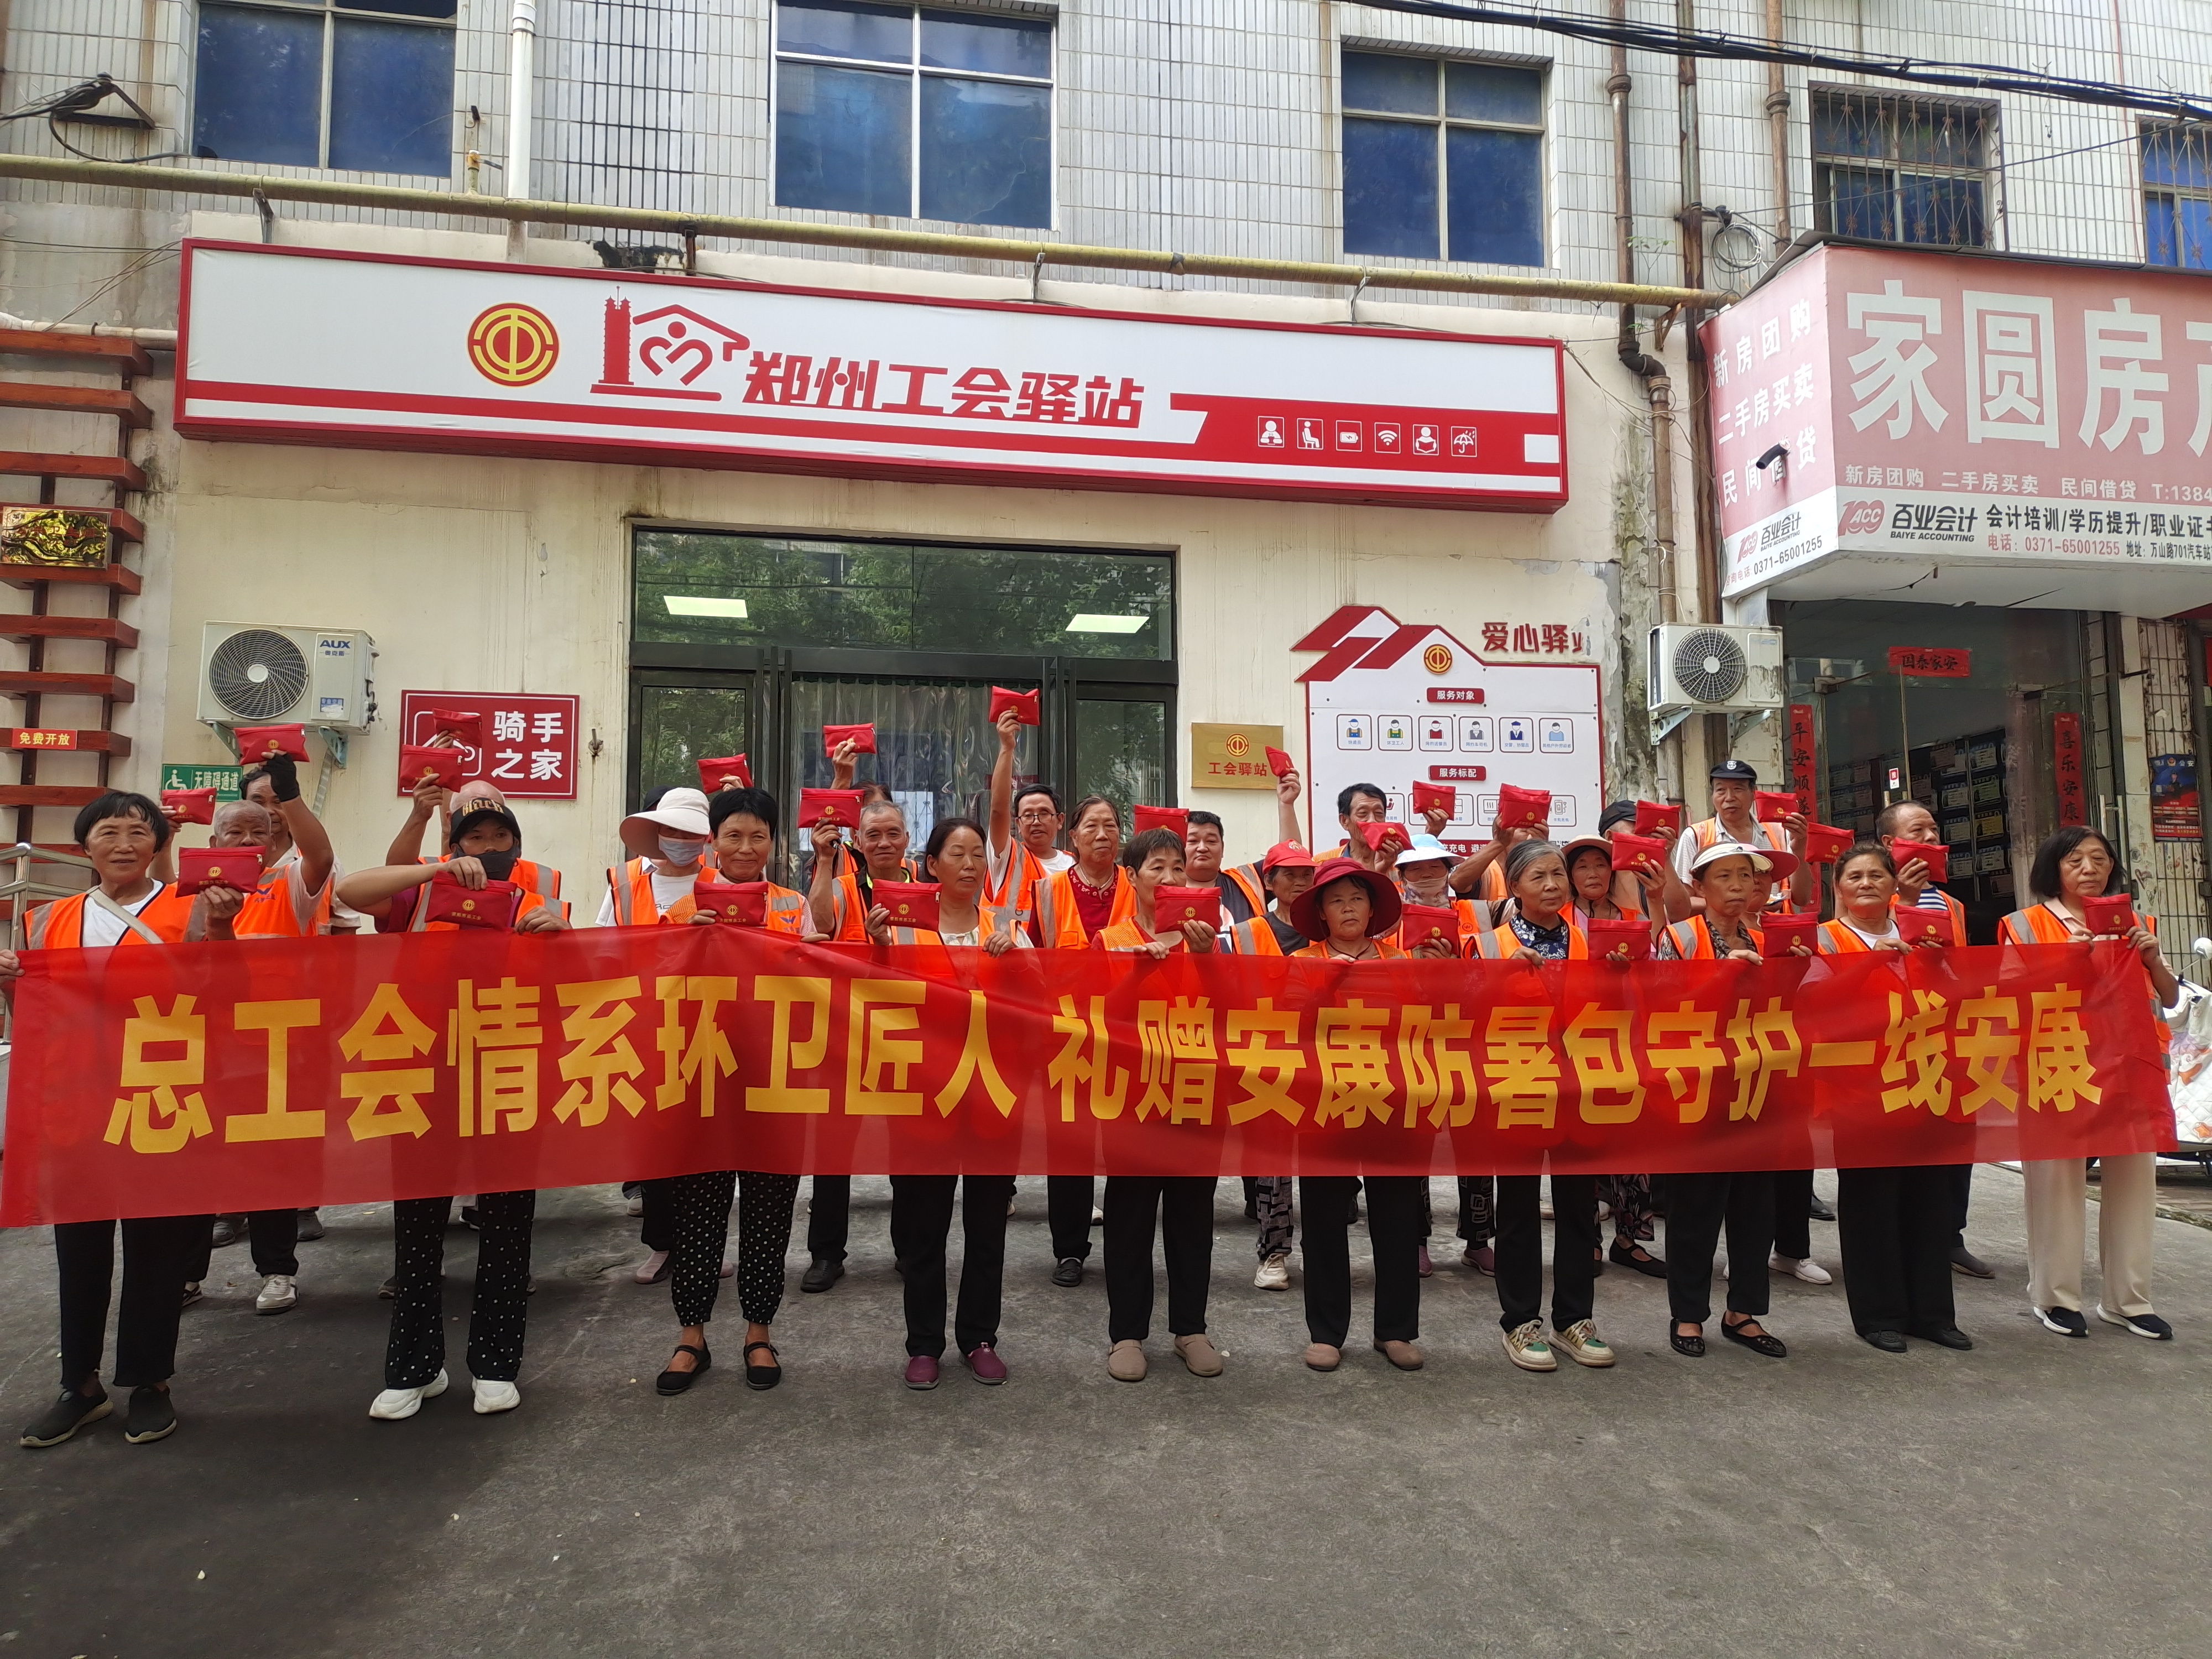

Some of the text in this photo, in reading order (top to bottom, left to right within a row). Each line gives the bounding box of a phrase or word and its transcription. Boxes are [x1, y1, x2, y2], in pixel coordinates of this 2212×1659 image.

[1713, 298, 1811, 389] 新房团购
[1847, 279, 2212, 458] 家圆房
[742, 351, 1145, 429] 郑州工会驿站
[1719, 362, 1814, 445] 二手房买卖
[1845, 464, 1924, 488] 新房团购
[1942, 471, 2039, 494] 二手房买卖
[2061, 477, 2137, 499] 民间借贷
[1761, 512, 1802, 545] 百业会计
[1892, 503, 1979, 533] 百业会计
[1760, 530, 1801, 552] BAIYE ACCOUNTING
[1890, 531, 1975, 542] BAIYE ACCOUNTING
[320, 640, 351, 649] AUX
[1437, 690, 1475, 701] 服务对象
[19, 732, 70, 746] 免费开放
[493, 711, 564, 743] 骑手
[491, 748, 564, 780] 之家
[1208, 761, 1267, 777] 工会驿站
[1439, 768, 1477, 778] 服务标配
[194, 771, 239, 791] 无障碍通道
[103, 975, 2103, 1154] 总工会情系环卫匠人 礼赠安康防暑包守护一线安康
